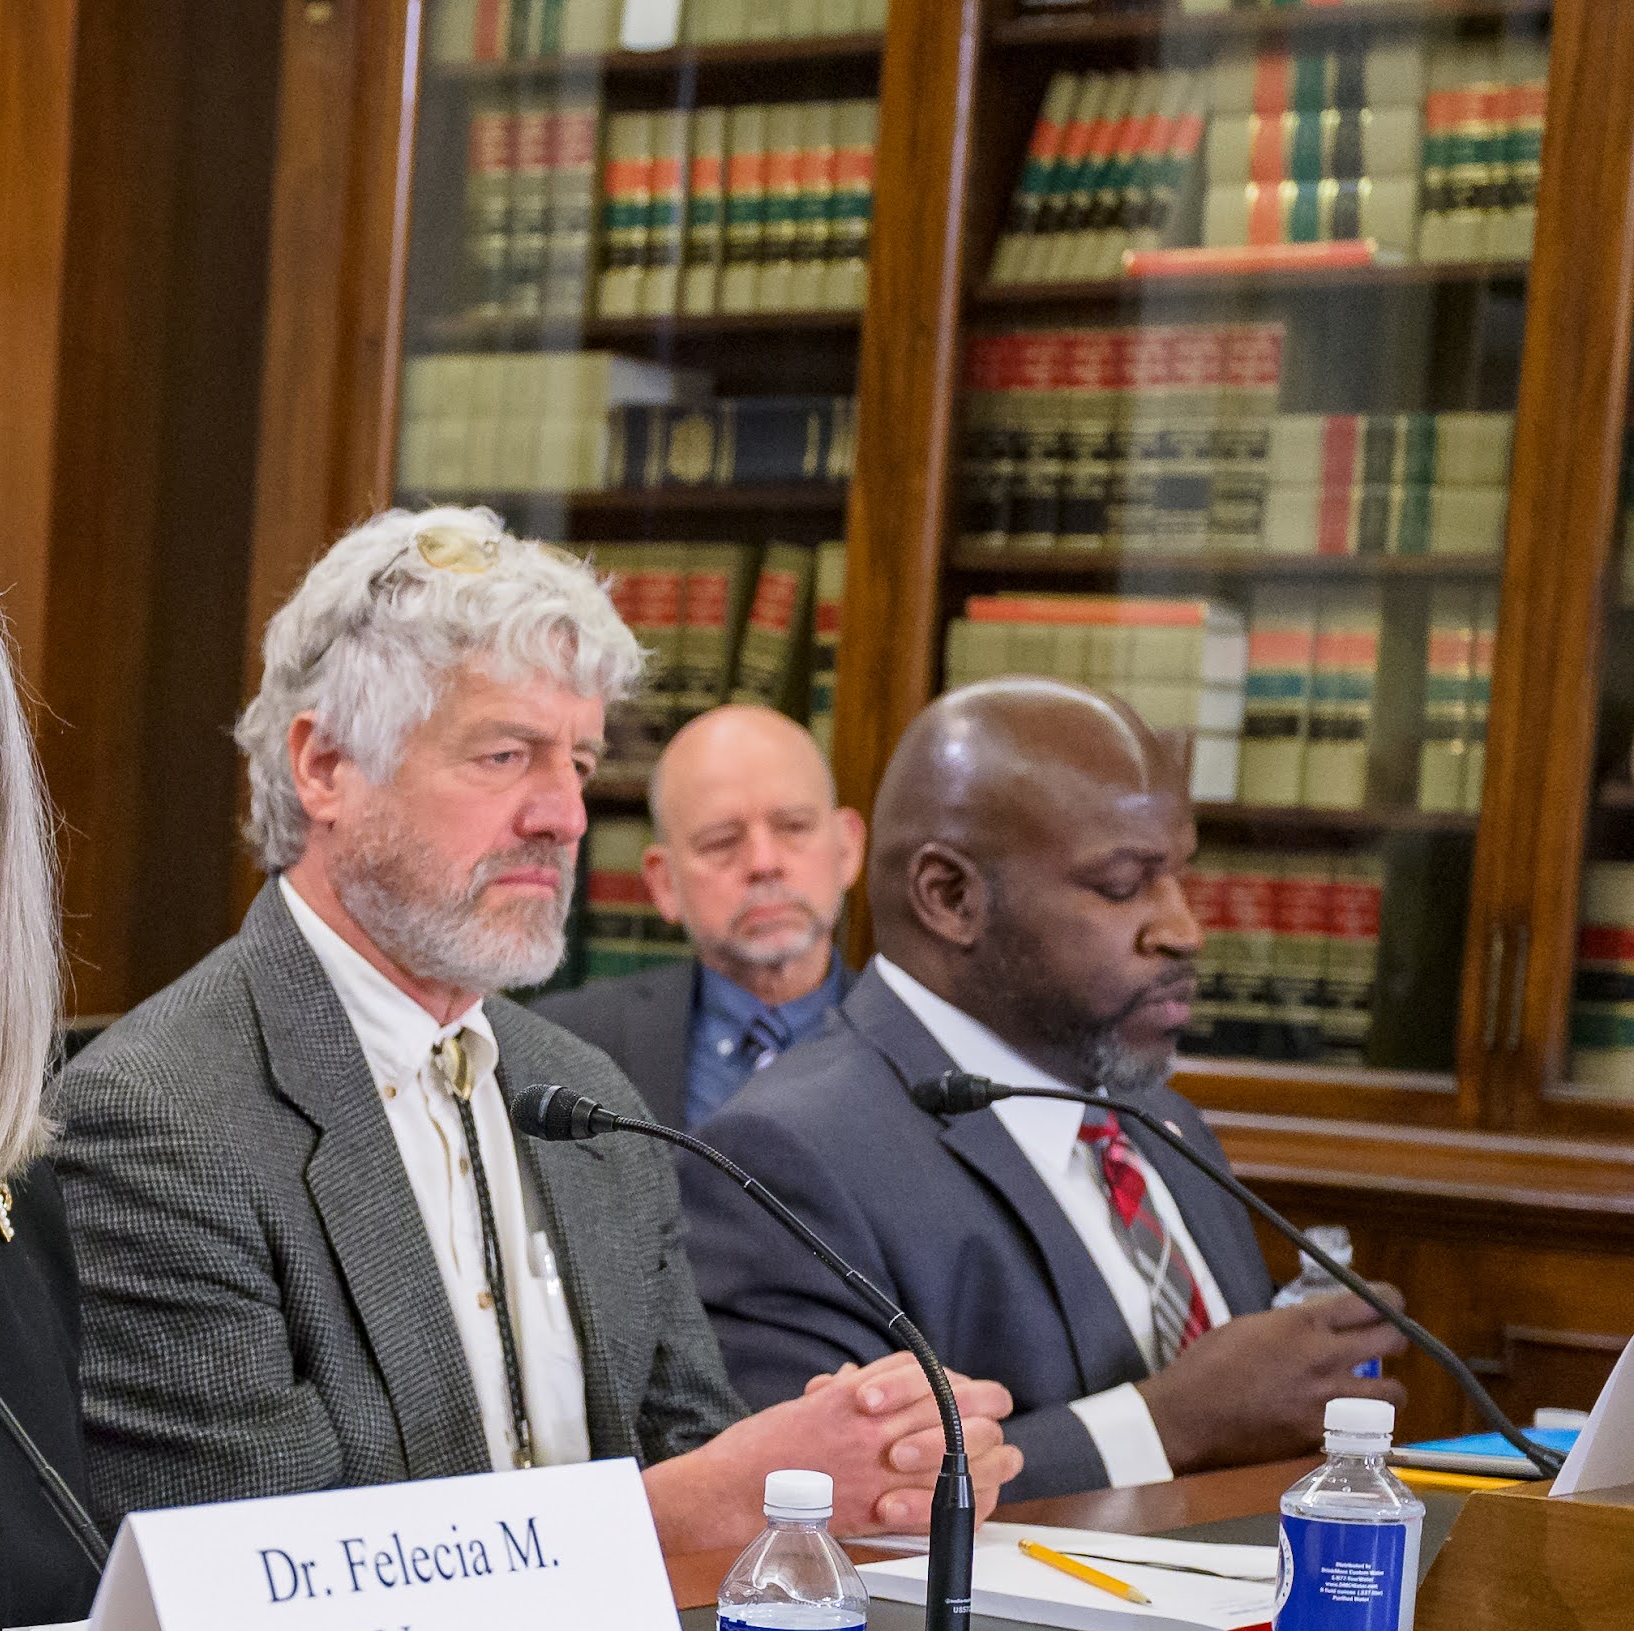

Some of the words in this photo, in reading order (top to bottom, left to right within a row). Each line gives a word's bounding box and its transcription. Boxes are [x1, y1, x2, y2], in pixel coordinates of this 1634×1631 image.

[259, 1547, 333, 1603] Dr.
[340, 1524, 494, 1593] Felecia
[498, 1516, 560, 1572] M.
